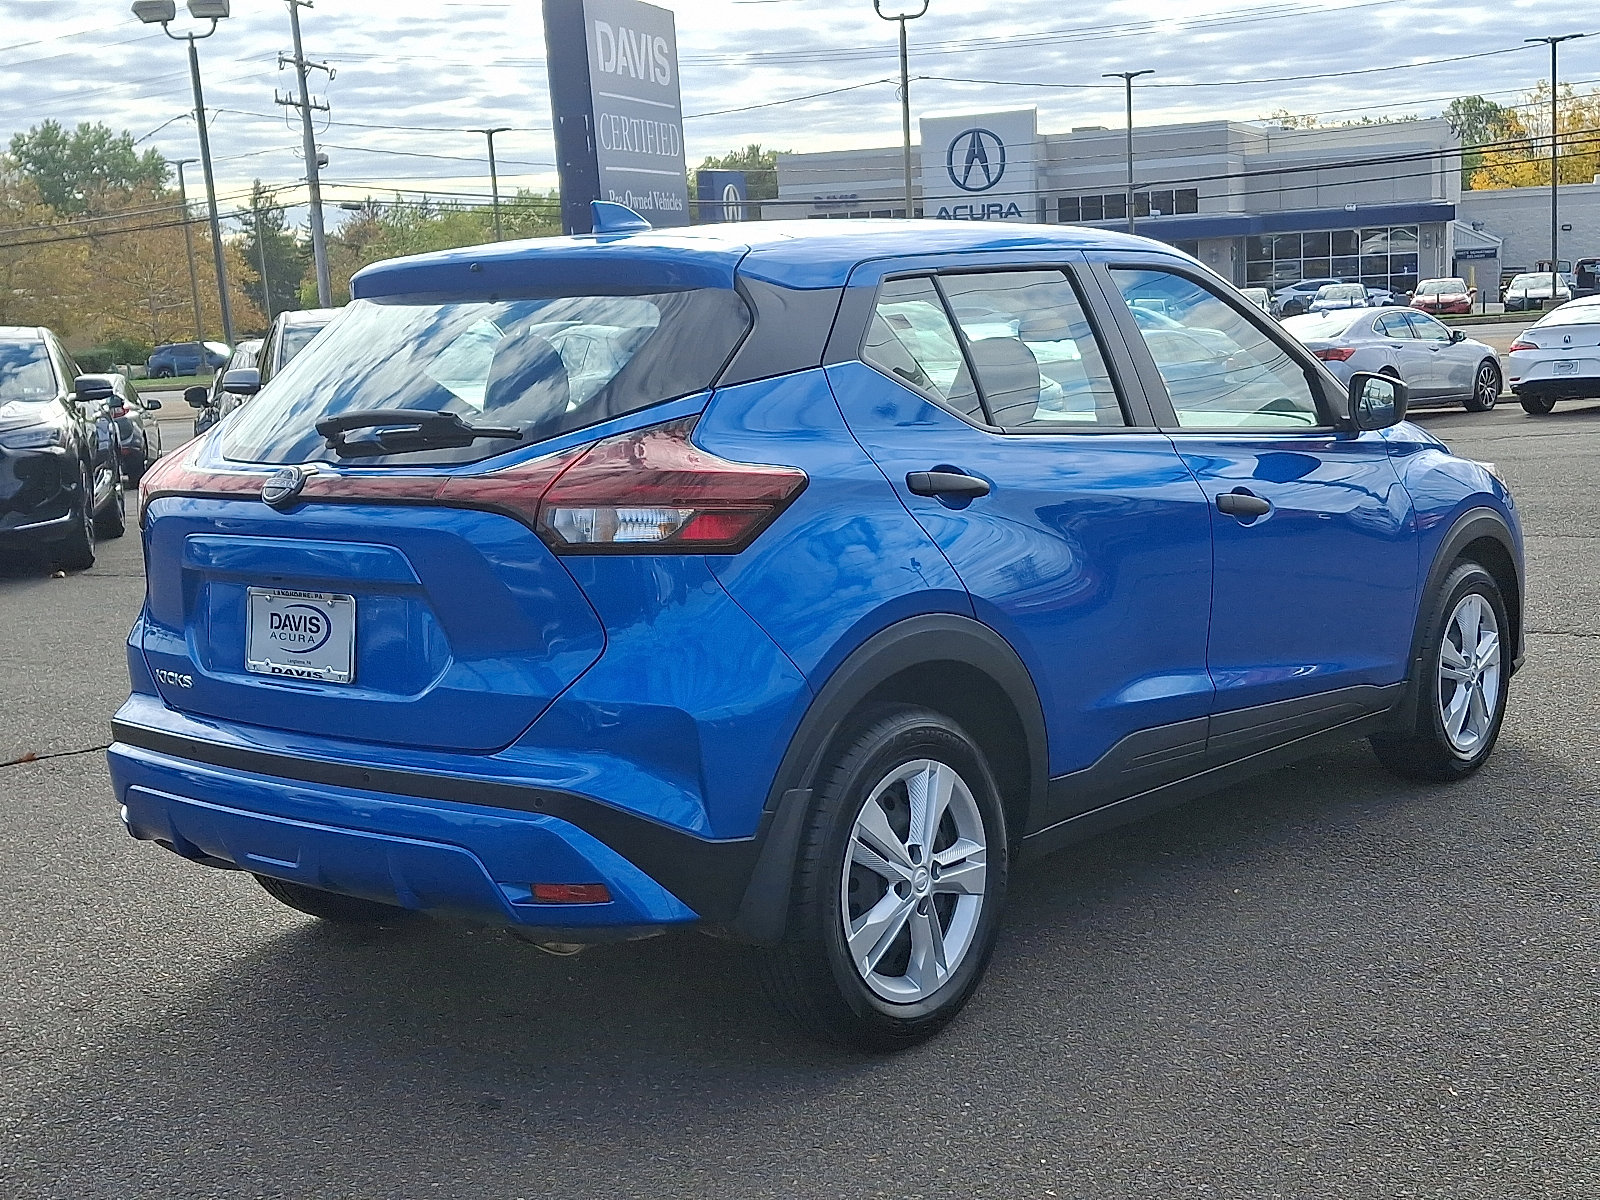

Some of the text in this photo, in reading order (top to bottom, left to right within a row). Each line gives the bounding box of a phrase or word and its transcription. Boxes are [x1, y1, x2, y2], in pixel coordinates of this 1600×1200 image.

[594, 19, 671, 86] DAVIS
[599, 112, 680, 157] CERTIFIED
[609, 190, 683, 211] Pre-Owned Vehicles
[936, 202, 1022, 220] ACURA
[270, 612, 321, 634] DAVIS
[269, 631, 315, 643] ACURA
[155, 668, 194, 689] KICKS
[271, 667, 324, 679] DAVIS
